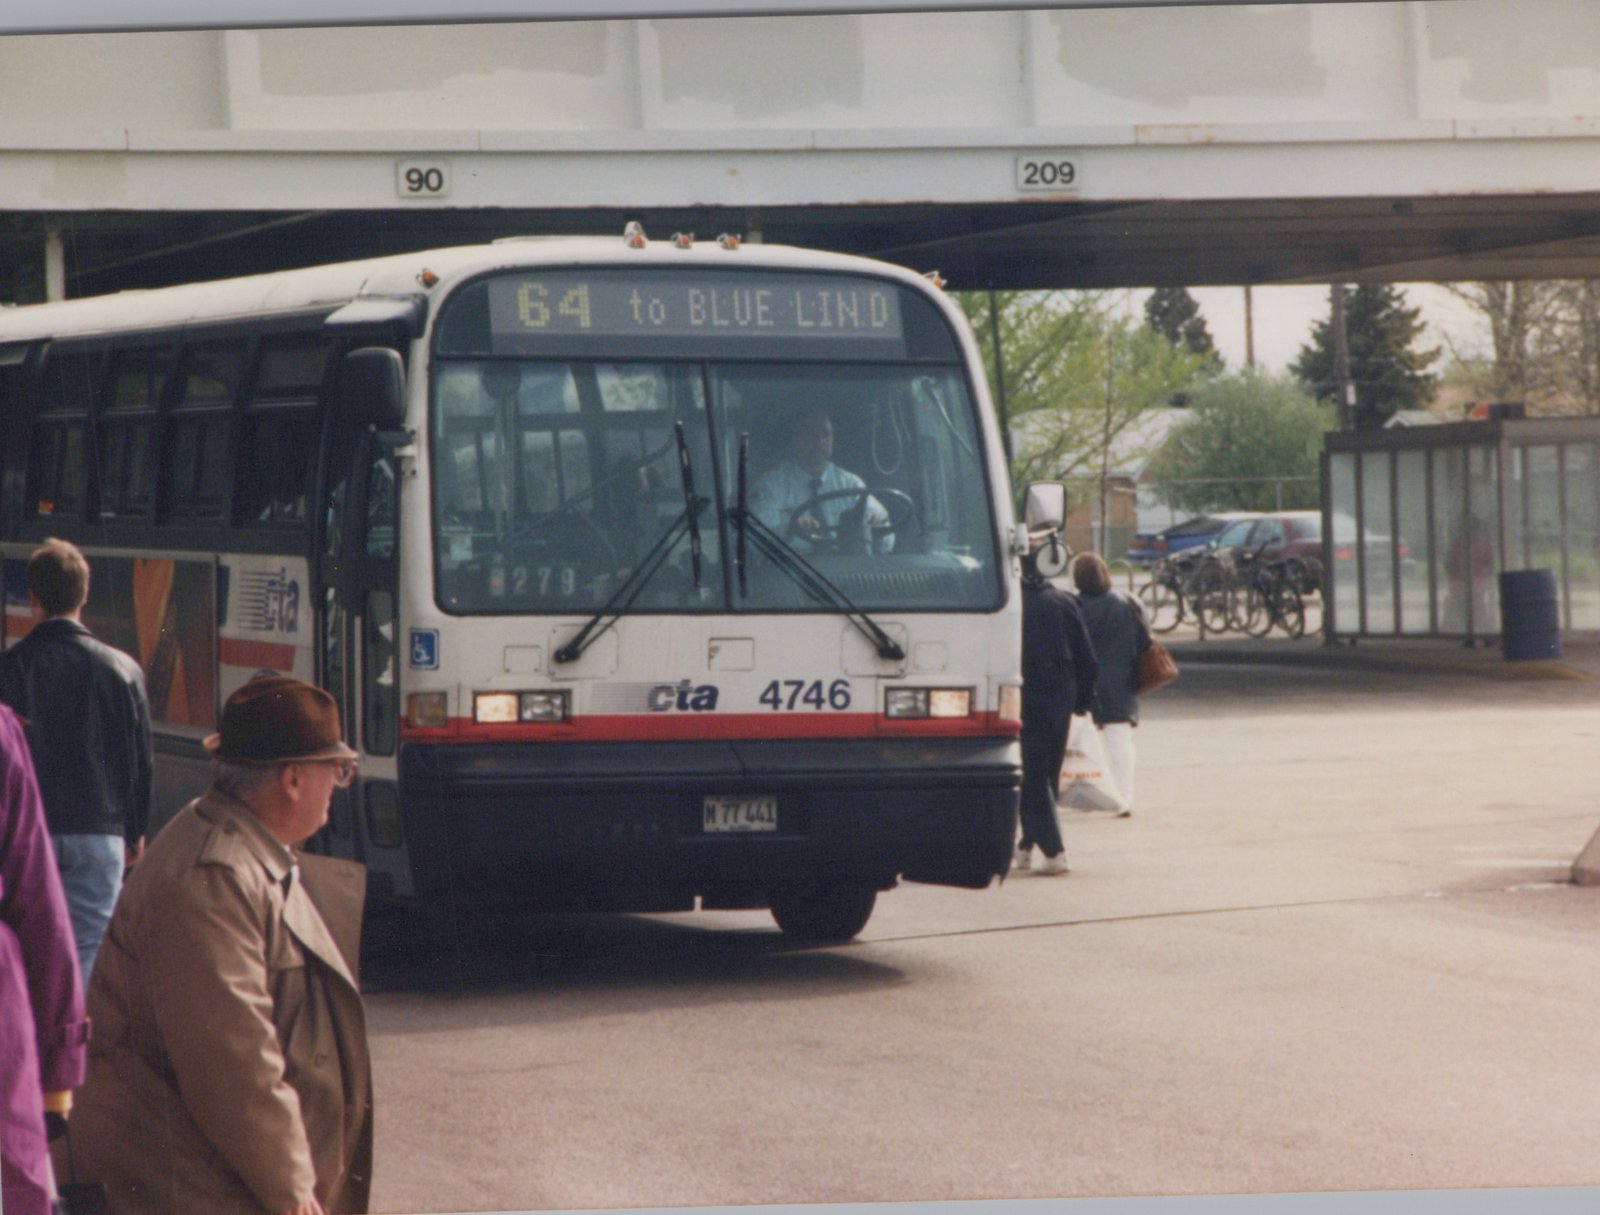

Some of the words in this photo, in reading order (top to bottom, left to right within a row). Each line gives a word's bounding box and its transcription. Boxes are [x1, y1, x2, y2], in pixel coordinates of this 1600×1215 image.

[405, 167, 443, 192] 90
[1024, 161, 1075, 185] 209
[518, 283, 591, 328] 64
[630, 288, 666, 326] to
[688, 289, 774, 326] BLUE
[648, 679, 719, 712] cta
[759, 679, 852, 711] 4746
